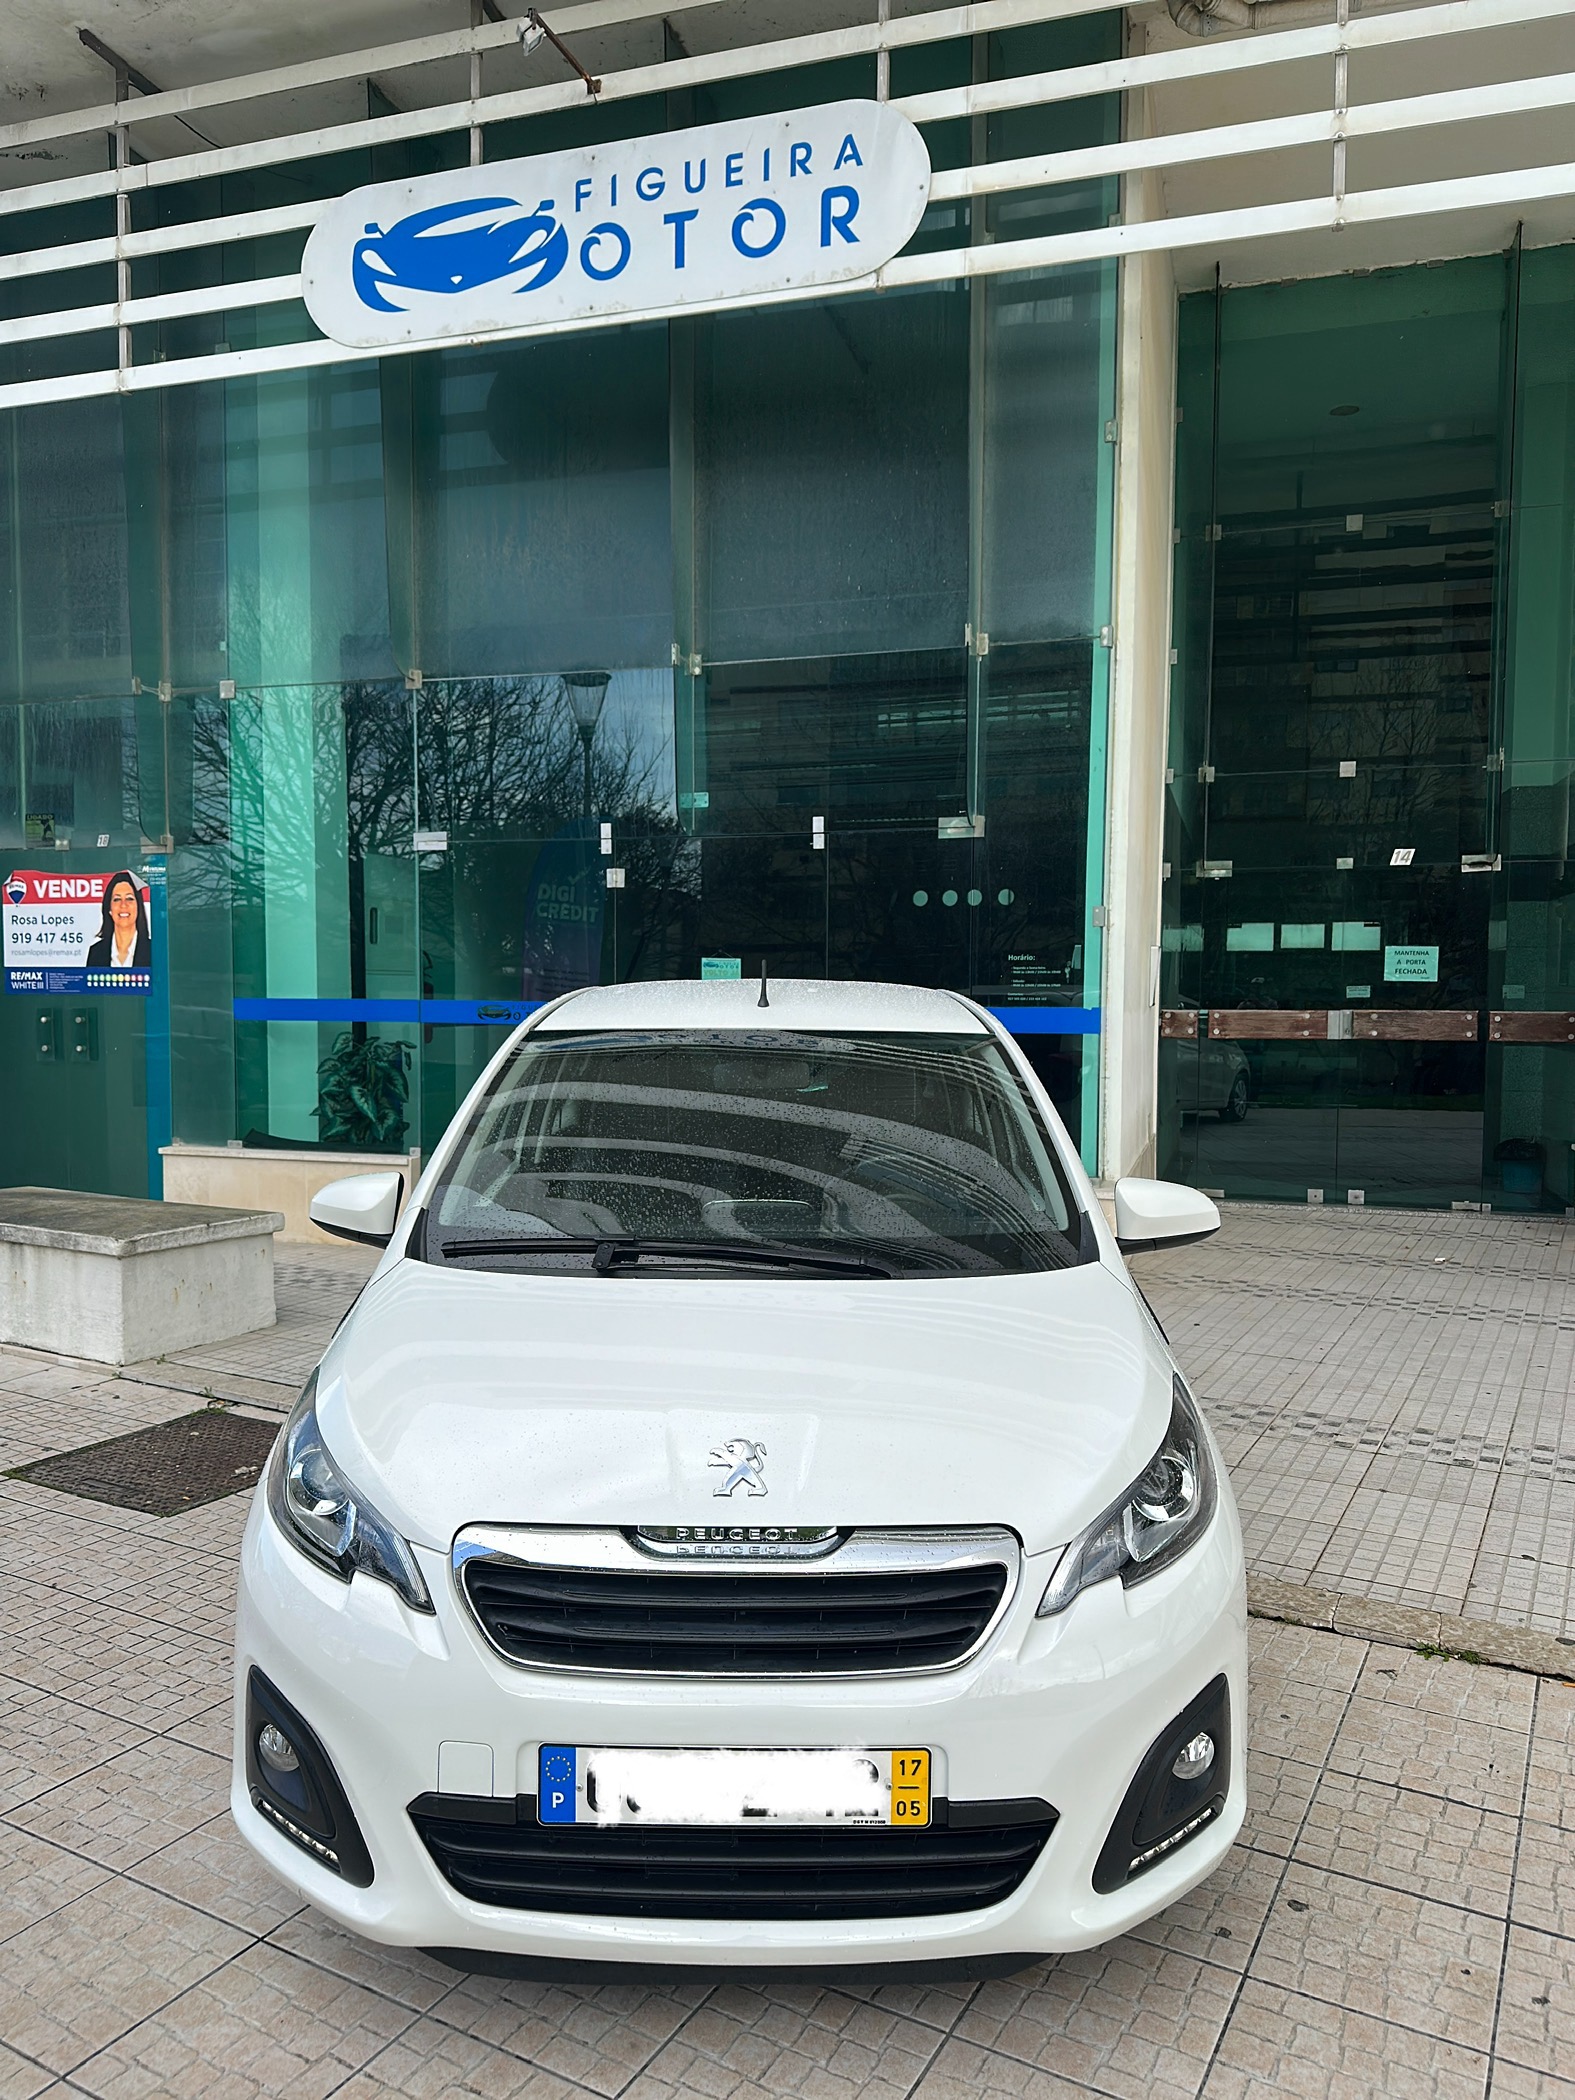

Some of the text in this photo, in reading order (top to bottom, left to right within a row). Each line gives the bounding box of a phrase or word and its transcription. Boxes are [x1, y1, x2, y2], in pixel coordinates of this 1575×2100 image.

[575, 133, 864, 212] FIGUEIRA
[1394, 850, 1412, 863] 14
[33, 879, 103, 898] VENDE
[538, 883, 575, 903] DIGI
[537, 902, 599, 922] CREDIT
[11, 914, 74, 927] Rosa Lopes
[11, 932, 83, 943] 919 417 456
[10, 971, 43, 980] RE/MAX
[676, 1528, 798, 1540] PEUGEOT
[899, 1760, 921, 1776] 17
[552, 1792, 565, 1808] P
[895, 1800, 921, 1816] 05
